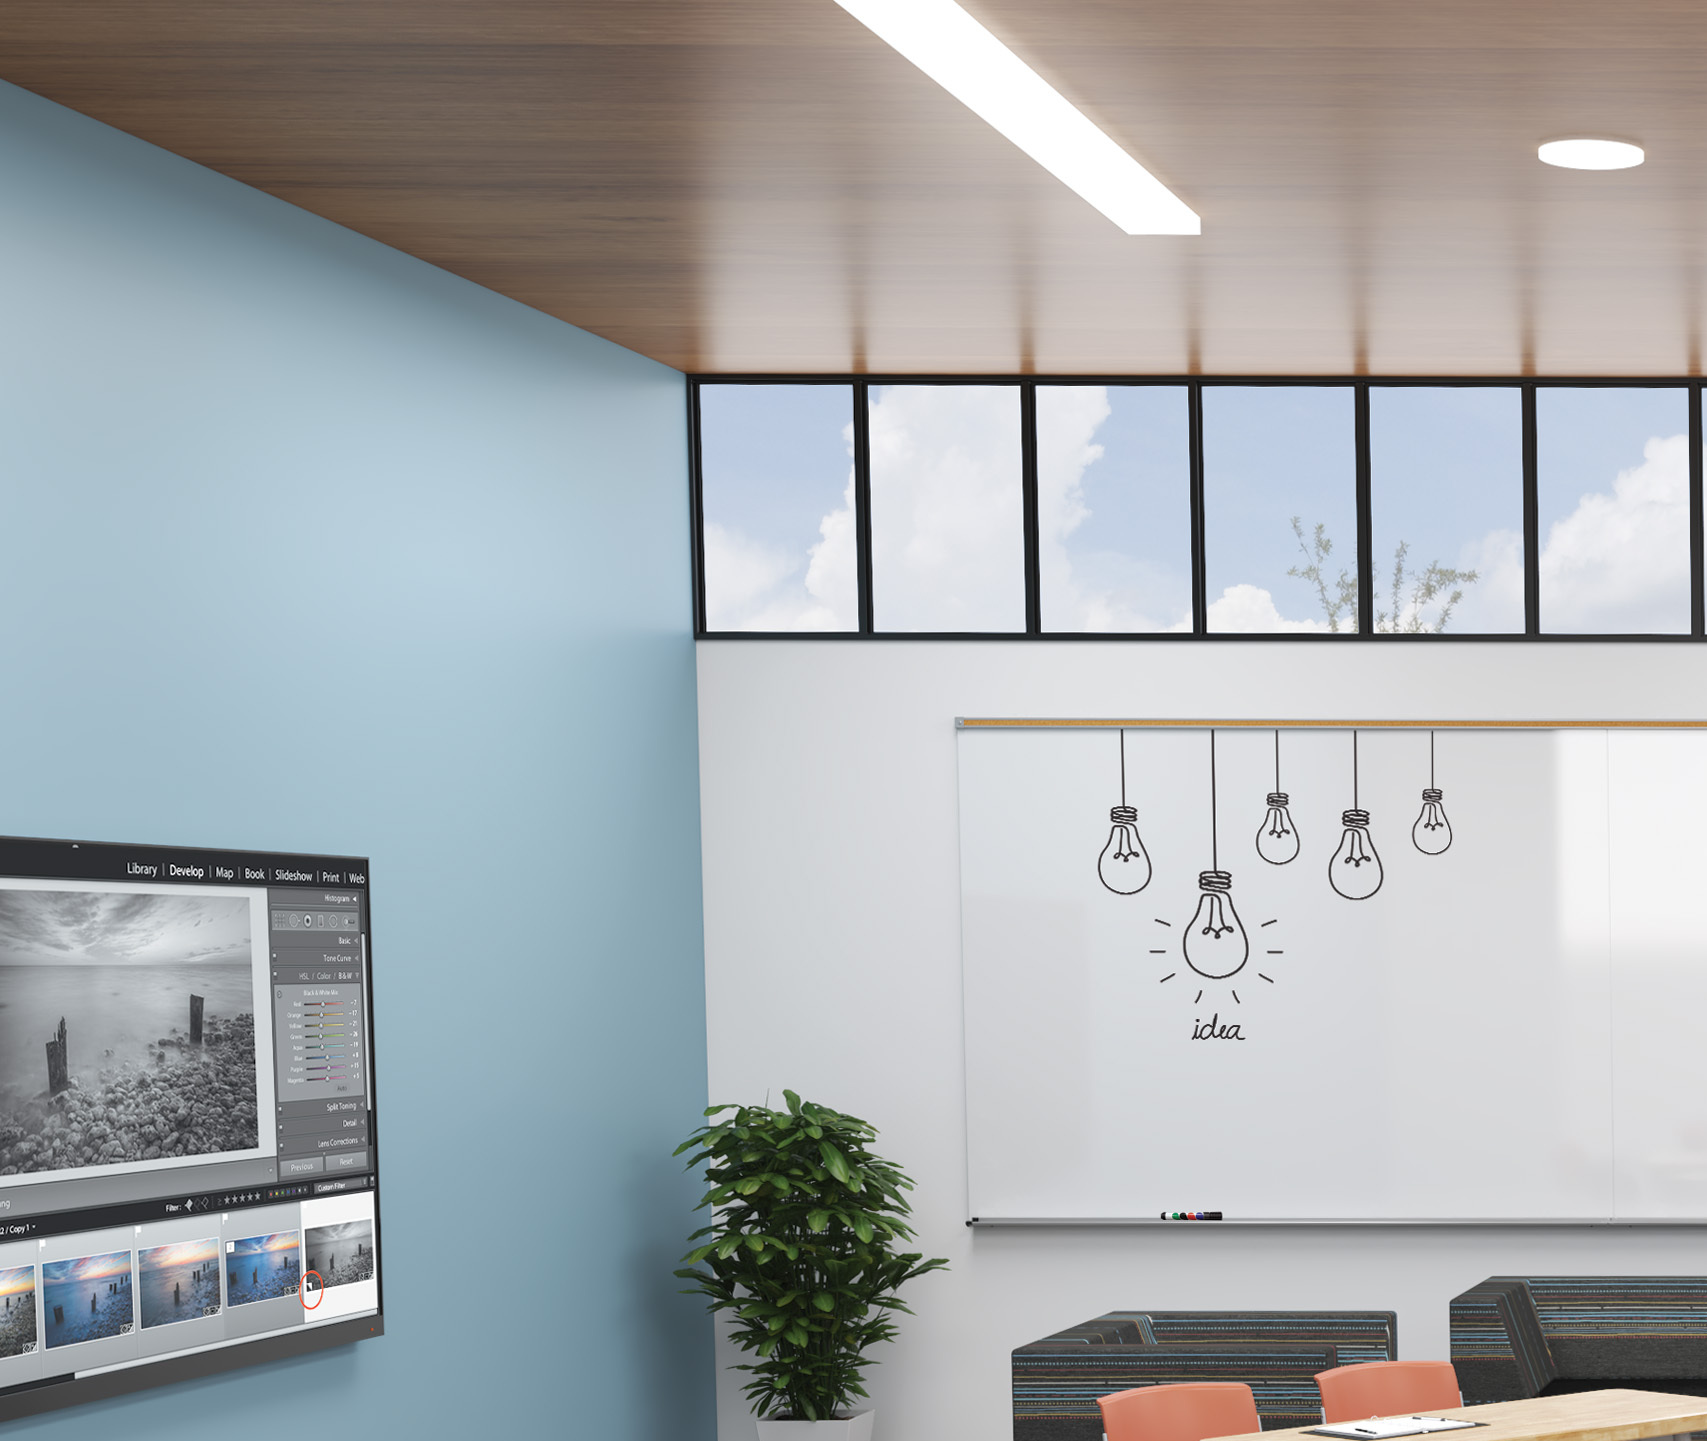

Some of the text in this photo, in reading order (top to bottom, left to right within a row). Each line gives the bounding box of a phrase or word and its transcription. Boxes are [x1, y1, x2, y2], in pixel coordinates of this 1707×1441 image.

[127, 862, 365, 884] Library Develop Map Book Slideshow Print Web
[324, 894, 350, 903] Histogram
[338, 936, 351, 945] Basic
[323, 954, 351, 963] Tone Curve
[1191, 1013, 1246, 1041] idea
[326, 1102, 357, 1112] Split Toning
[342, 1119, 357, 1127] Detail
[290, 1158, 354, 1172] Previous Reset
[10, 1225, 25, 1234] Copy
